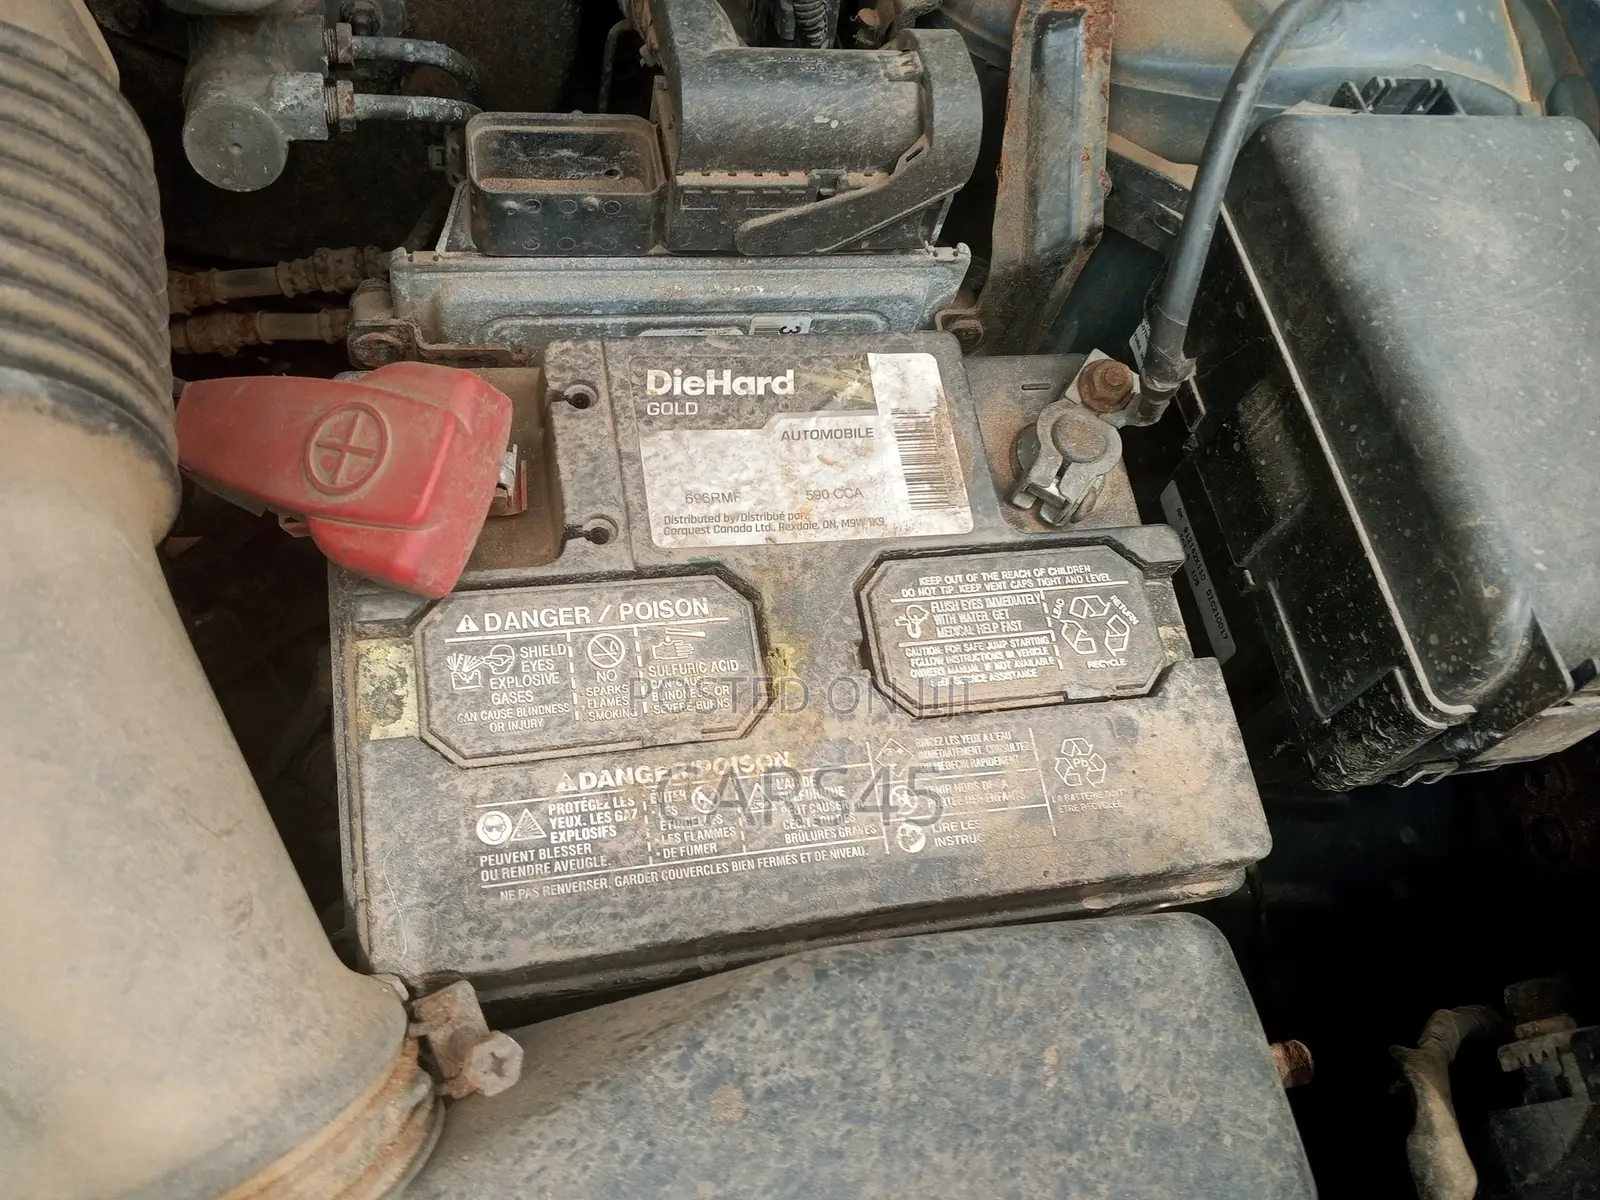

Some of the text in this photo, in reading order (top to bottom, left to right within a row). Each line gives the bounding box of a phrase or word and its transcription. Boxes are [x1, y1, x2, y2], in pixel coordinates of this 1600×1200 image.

[646, 369, 795, 396] DieHard
[646, 402, 698, 416] GOLD
[781, 427, 874, 441] AUTOMOBILE
[806, 487, 864, 500] 590 CCA
[664, 513, 721, 525] Distributed
[723, 511, 785, 524] by/Distribué
[713, 523, 752, 534] Canada
[779, 521, 820, 532] Rexdale,
[822, 520, 839, 530] ON,
[919, 565, 1091, 586] KEEP OUT OF THE REACH OF CHILDREN
[901, 588, 915, 598] DO
[918, 586, 936, 597] NOT
[959, 584, 981, 593] KEEP
[983, 581, 1007, 591] VENT
[1010, 579, 1034, 589] CAPS
[1036, 576, 1061, 586] TIGHT
[1065, 575, 1085, 584] AND
[1086, 573, 1112, 582] LEVEL
[930, 593, 1040, 614] FLUSH EYES IMMEDIATELY
[1051, 598, 1065, 620] LEAD
[1110, 594, 1140, 626] RETURN
[484, 606, 591, 632] DANGER
[619, 597, 710, 622] POISON
[932, 613, 957, 626] WITH
[992, 608, 1009, 620] GET
[936, 620, 1023, 638] MEDICAL HELP FAST
[519, 643, 567, 659] SHIELD
[944, 643, 962, 654] FOR
[963, 642, 984, 653] SAFE
[985, 640, 1008, 651] JUMP
[1009, 636, 1051, 648] STARTING
[521, 658, 555, 673] EYES
[910, 647, 1050, 668] FOLLOW INSTRUCTIONS IN VEHICLE
[983, 661, 993, 672] IF
[994, 660, 1013, 671] NOT
[1014, 657, 1056, 669] AVAILABLE
[1086, 658, 1127, 670] RECYCLE
[596, 668, 618, 683] NO
[648, 659, 739, 677] SULFURIC ACID
[989, 668, 1039, 682] ASSISTANCE
[489, 672, 560, 690] EXPLOSIVE
[491, 690, 534, 706] GASES
[585, 684, 629, 697] SPARKS
[651, 685, 730, 702] BLINDNESS OR
[587, 696, 630, 710] FLAMES
[696, 698, 730, 710] BURNS
[456, 702, 571, 724] CAN CAUSE BLINDNESS
[588, 708, 638, 722] SMOKING
[489, 717, 544, 733] OR INJURY
[945, 734, 960, 746] LES
[960, 733, 982, 745] YEUX
[1073, 757, 1089, 768] Pb
[612, 796, 635, 809] LES
[549, 816, 587, 830] YEUX.
[589, 811, 613, 825] LES
[931, 819, 981, 834] LIRE LES
[550, 825, 617, 844] EXPLOSIFS
[684, 826, 737, 842] FLAMMES
[784, 829, 837, 844] BRÛLURES
[479, 843, 592, 867] PEUVENT BLESSER
[663, 842, 718, 859] DE FUMER
[480, 856, 612, 882] OU RENDRE AVEUGLE.
[500, 888, 515, 901] NE
[518, 887, 540, 900] PAS
[614, 871, 659, 887] GARDER
[661, 862, 729, 881] COUVERCLES
[731, 859, 755, 872] BIEN
[757, 852, 798, 868] FERMÉS
[800, 852, 812, 863] ET
[830, 846, 869, 859] NIVEAU.
